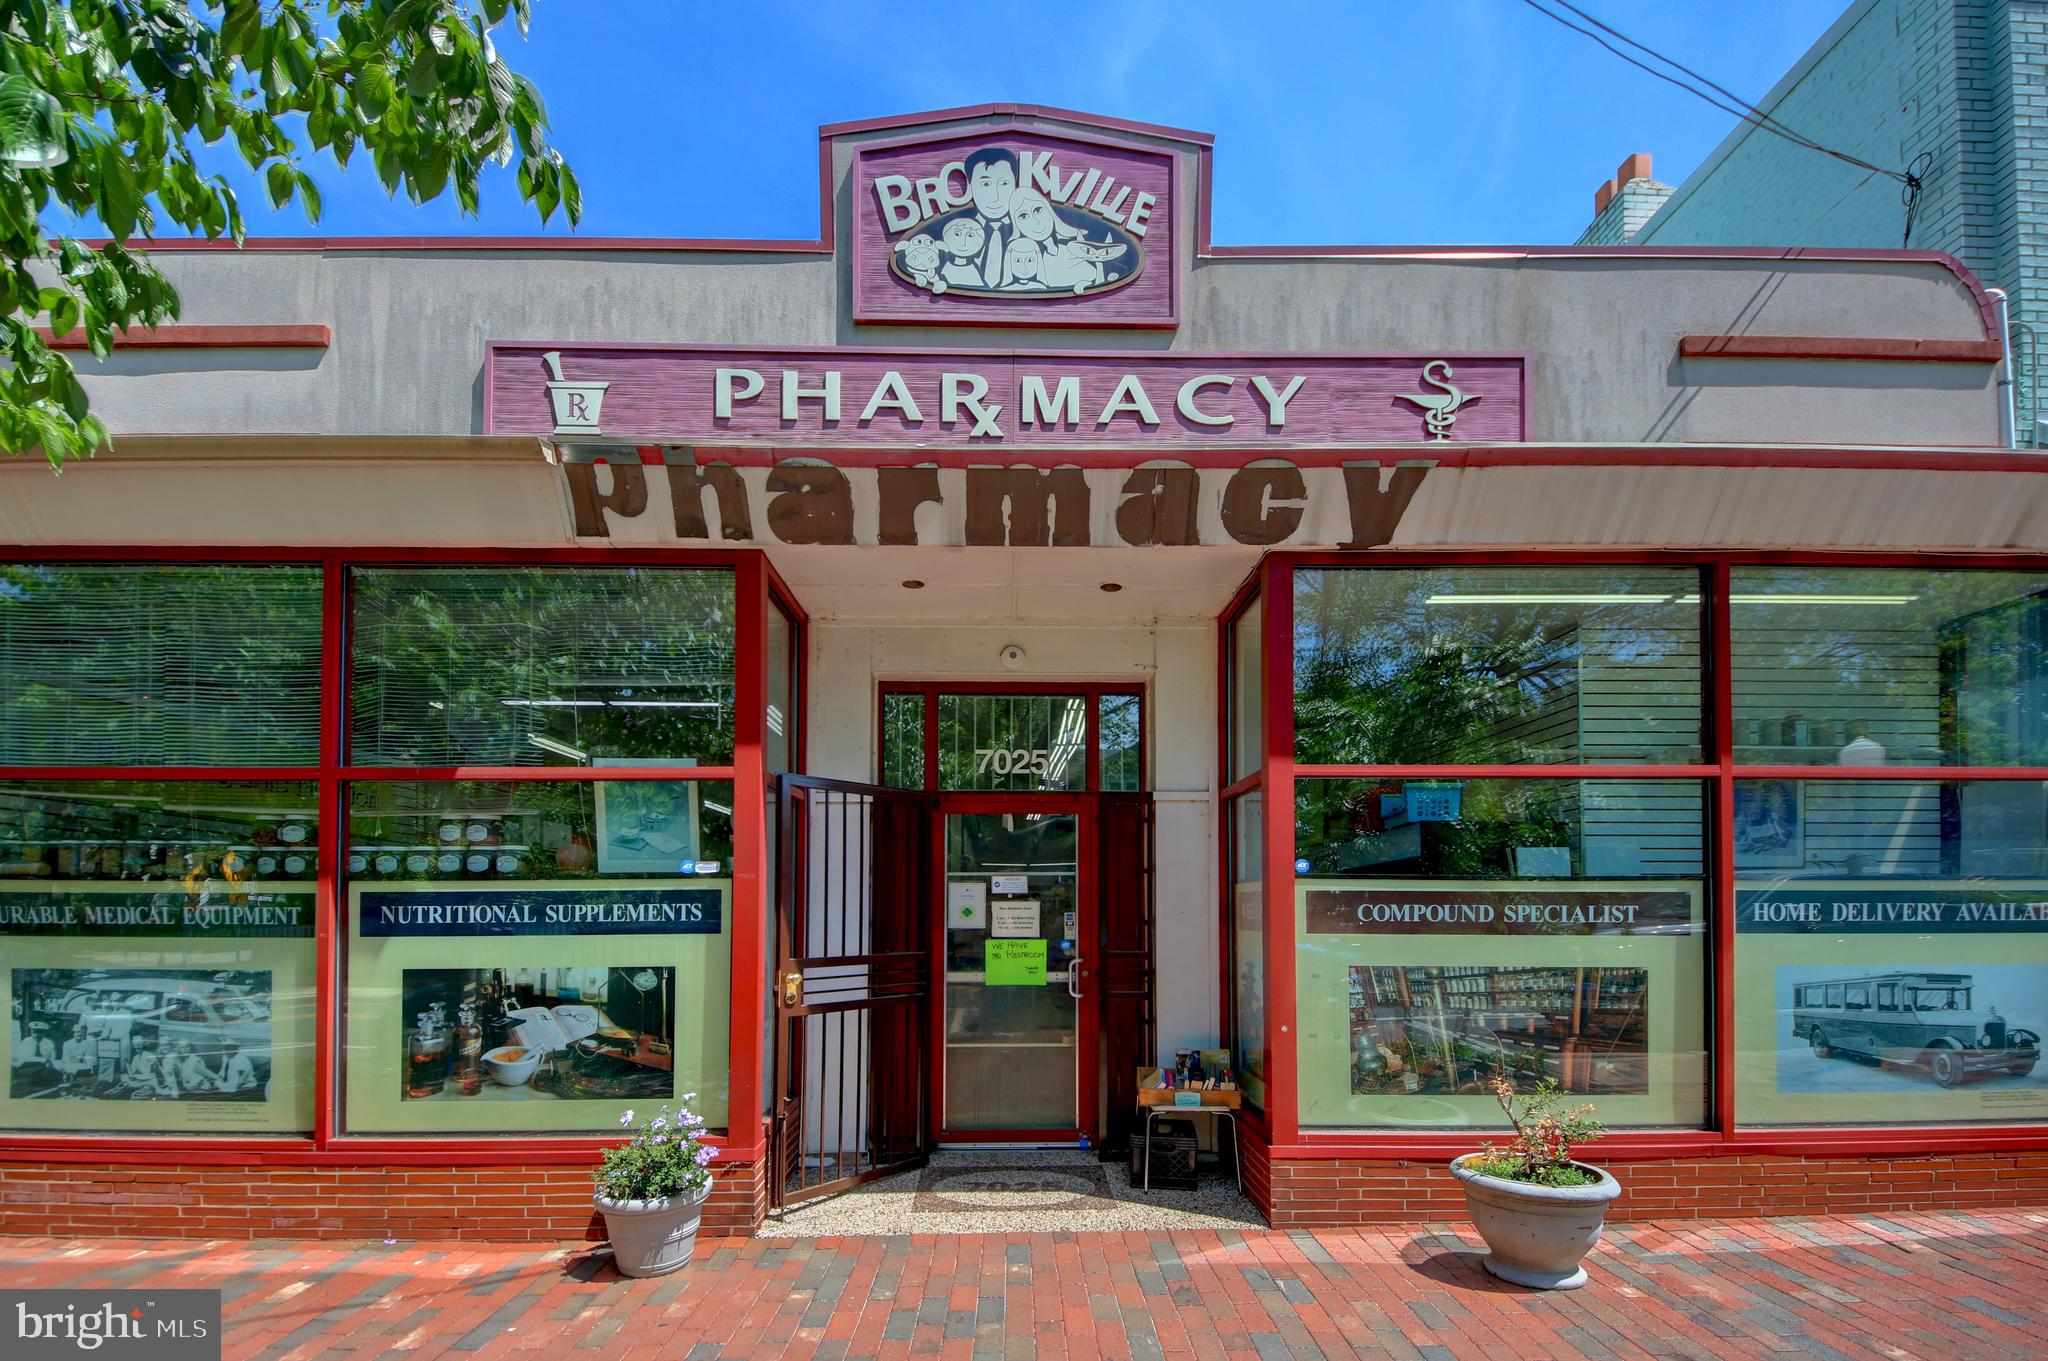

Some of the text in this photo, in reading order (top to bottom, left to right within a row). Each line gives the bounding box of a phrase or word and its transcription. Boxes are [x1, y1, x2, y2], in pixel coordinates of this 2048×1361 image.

[875, 151, 1156, 237] BROKVILLE
[715, 368, 1307, 437] PHARMACY
[976, 749, 1049, 775] 7025
[85, 906, 175, 925] MEDICAL
[183, 906, 301, 928] EQUIPMENT
[380, 903, 703, 924] NUTRITIONAL SUPPLEMENTS
[1357, 904, 1639, 924] COMPOUND SPECIALIST
[1753, 903, 1822, 922] HOME
[1832, 902, 1945, 922] DELIVERY
[1006, 950, 1044, 959] RESTROOM
